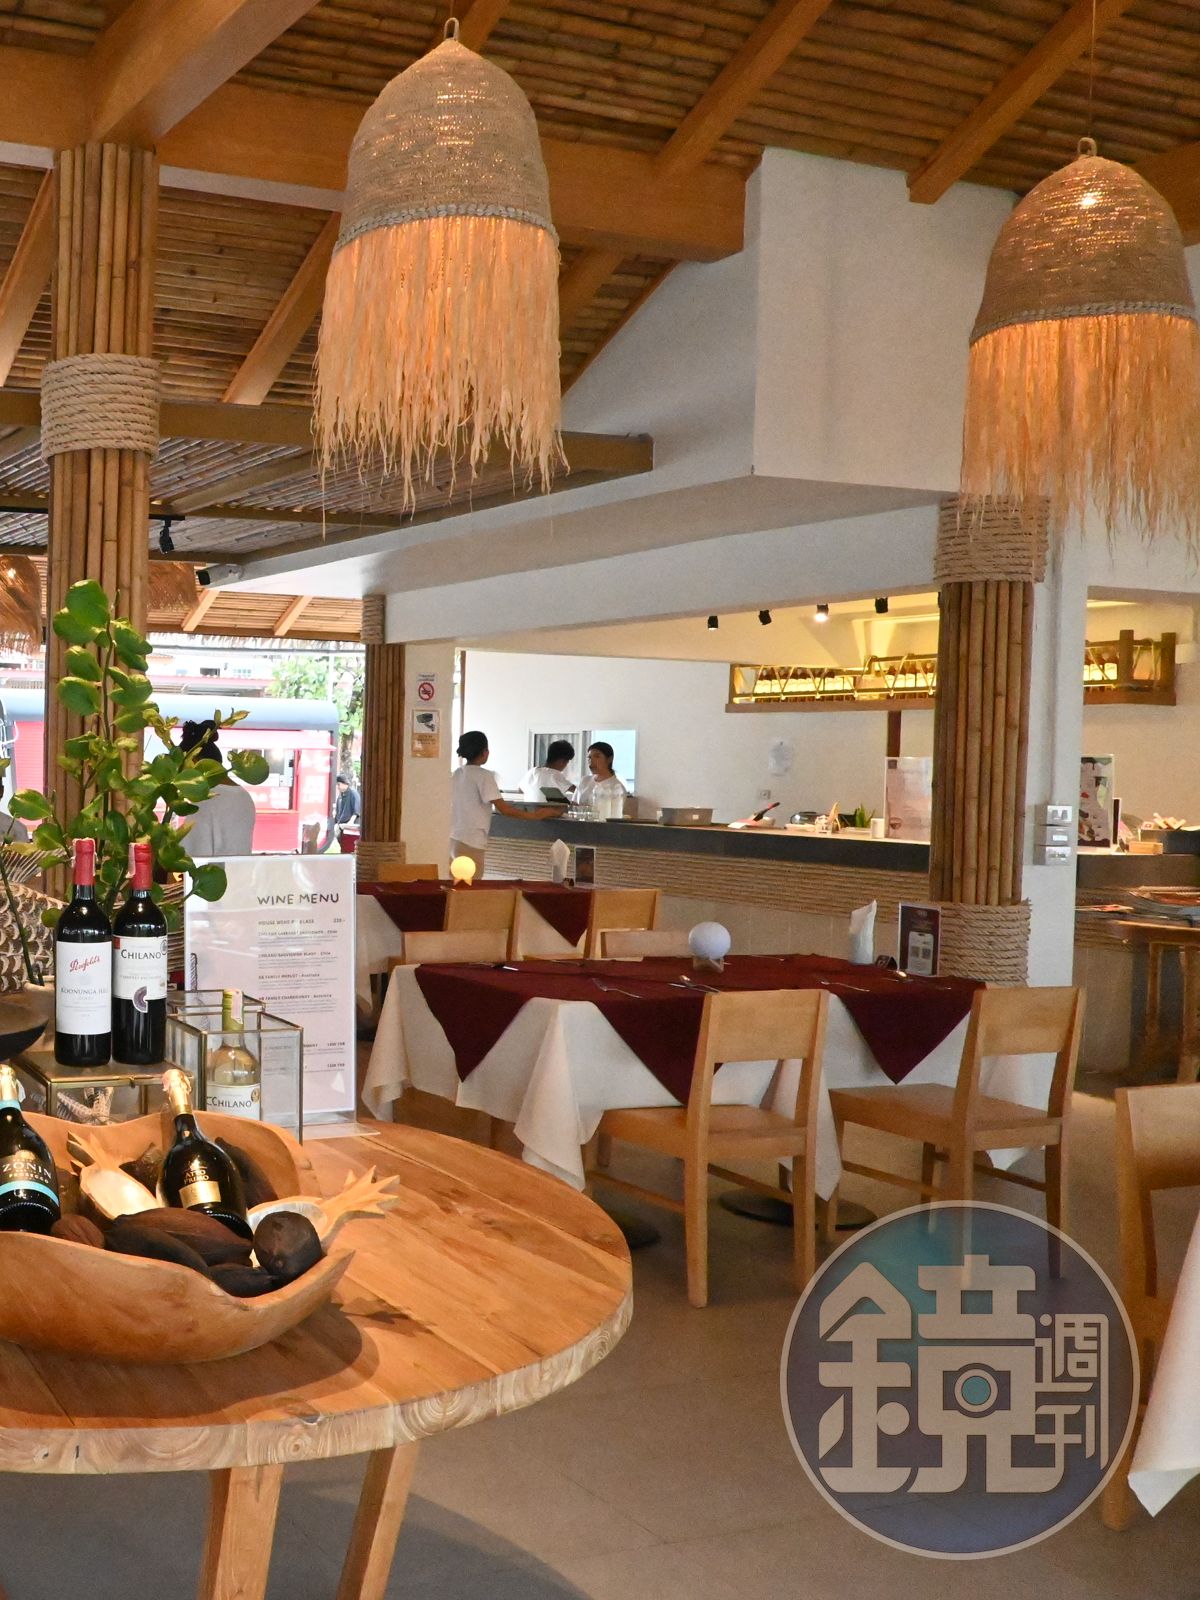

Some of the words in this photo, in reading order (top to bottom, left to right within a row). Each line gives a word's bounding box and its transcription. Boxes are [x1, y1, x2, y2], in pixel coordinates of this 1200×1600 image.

[257, 893, 294, 905] WINE
[299, 892, 340, 904] MENU
[120, 948, 161, 959] CHILANO
[2, 1161, 52, 1179] ZONIN
